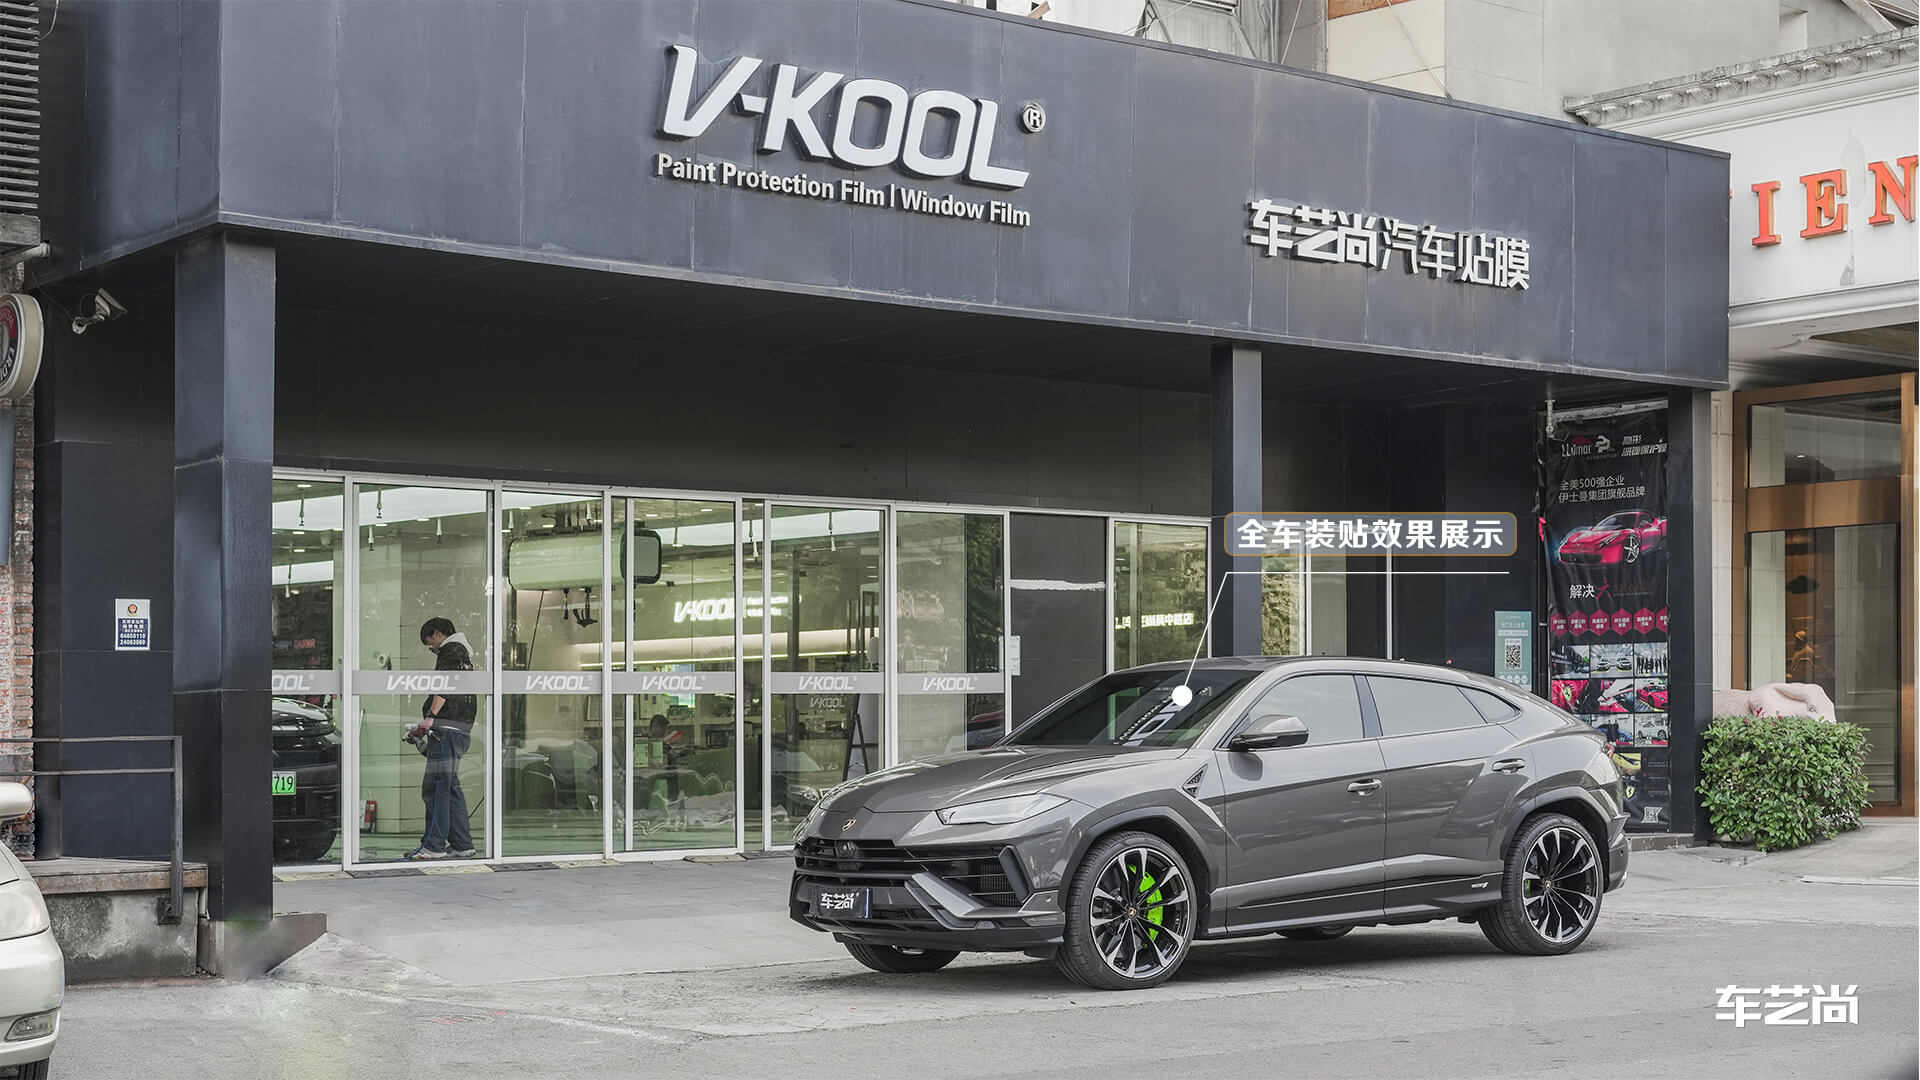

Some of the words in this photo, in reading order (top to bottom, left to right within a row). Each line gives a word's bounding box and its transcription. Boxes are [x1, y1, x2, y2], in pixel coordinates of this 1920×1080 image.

[660, 44, 1030, 188] V-KOOL
[657, 153, 716, 183] Paint
[722, 161, 835, 200] Protection
[841, 179, 885, 207] Film
[901, 187, 985, 219] Window
[990, 200, 1031, 227] Film
[1751, 154, 1919, 247] IEN
[1248, 198, 1531, 290] 车艺尚汽车贴膜
[1559, 474, 1625, 491] 全美500强企业
[1569, 584, 1595, 599] 解决
[673, 598, 737, 623] V-KOO
[272, 675, 311, 691] OOL
[273, 776, 294, 791] 719
[820, 892, 855, 910] 车艺尚
